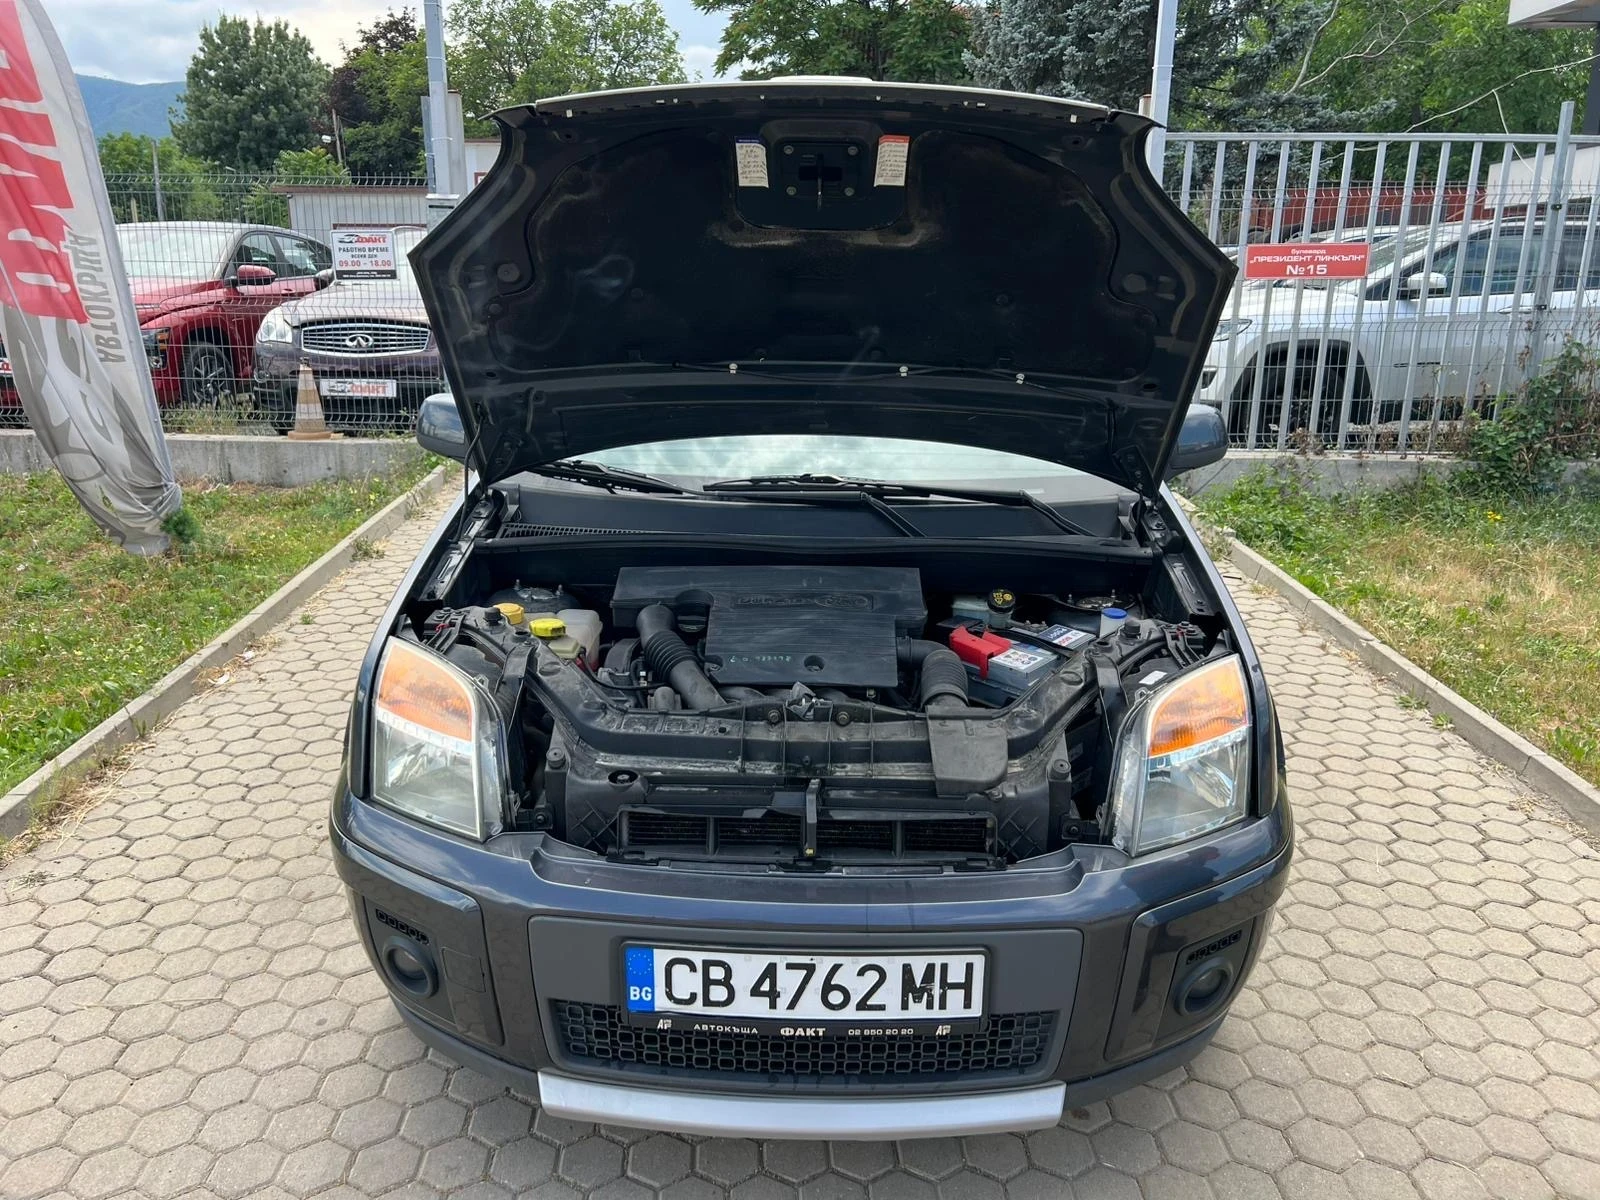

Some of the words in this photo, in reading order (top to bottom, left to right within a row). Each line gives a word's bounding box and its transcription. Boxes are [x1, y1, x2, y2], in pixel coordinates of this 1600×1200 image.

[630, 986, 652, 1001] BG
[749, 961, 887, 1011] 4762
[780, 1027, 826, 1036] ФАКТ
